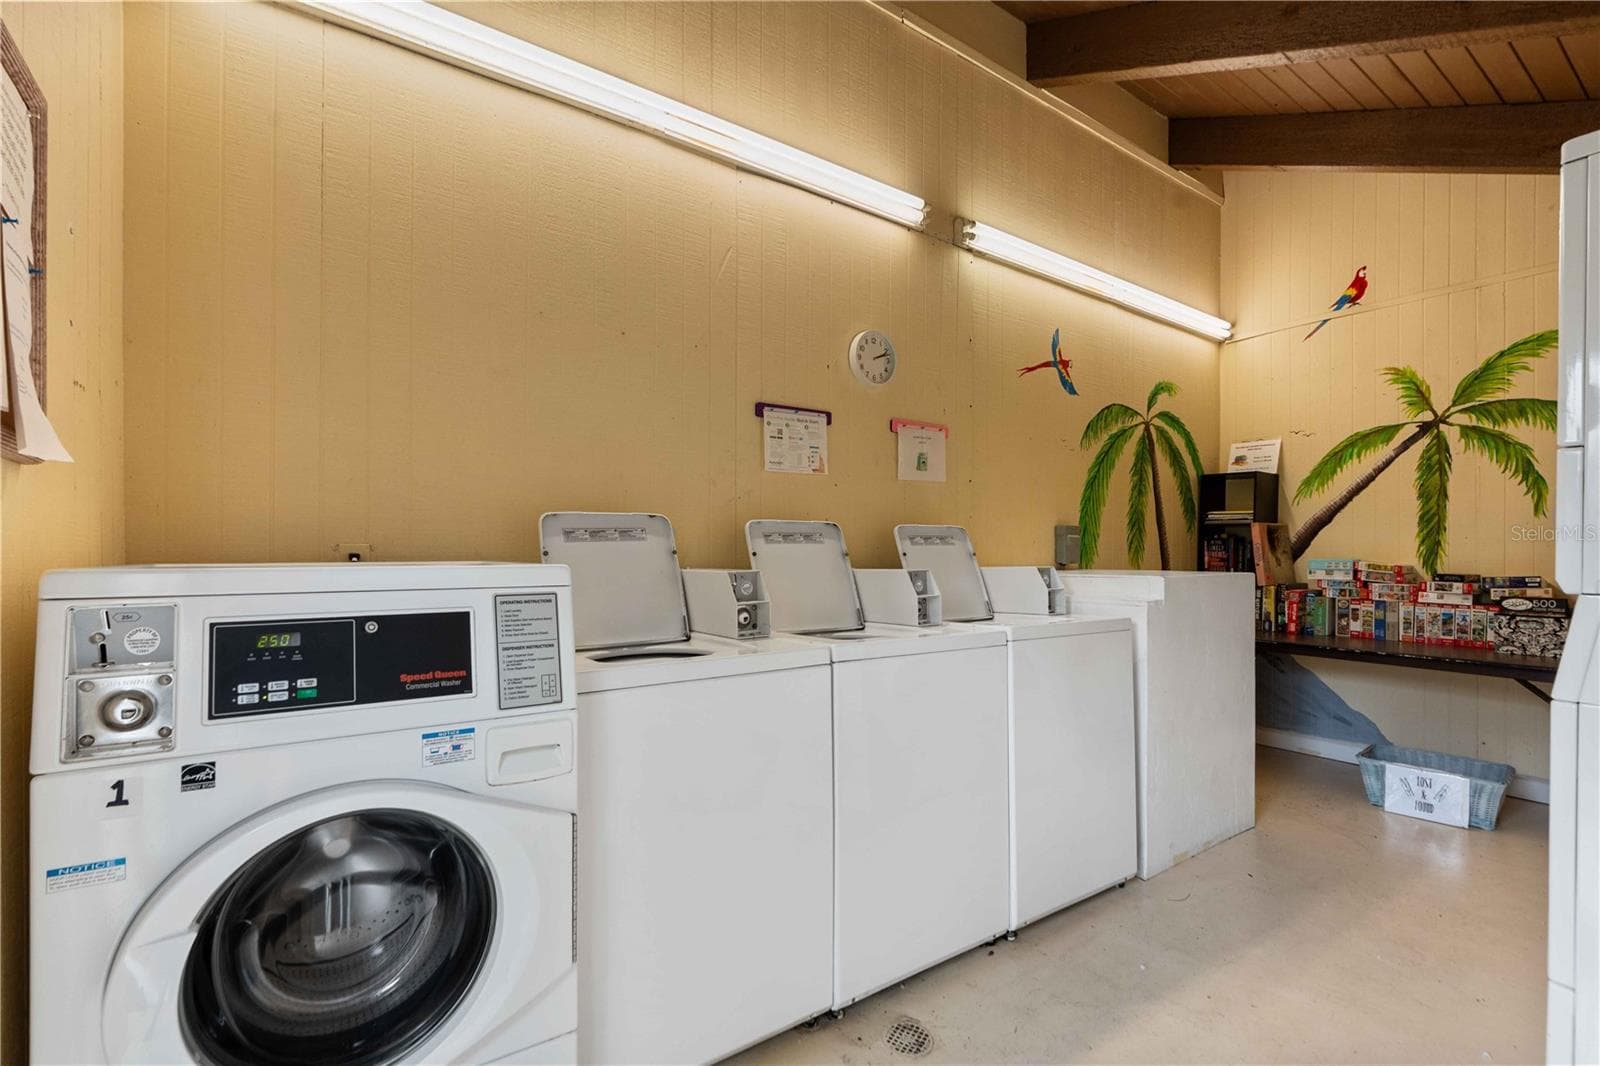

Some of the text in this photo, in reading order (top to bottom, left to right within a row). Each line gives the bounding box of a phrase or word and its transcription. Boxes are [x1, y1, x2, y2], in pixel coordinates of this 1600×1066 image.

[1532, 600, 1557, 608] 500
[257, 634, 290, 648] 250
[400, 670, 466, 682] Speed Queen
[406, 681, 440, 690] Commercial
[1416, 776, 1432, 788] LOST
[106, 778, 129, 808] 1
[58, 860, 116, 875] NOTICE
